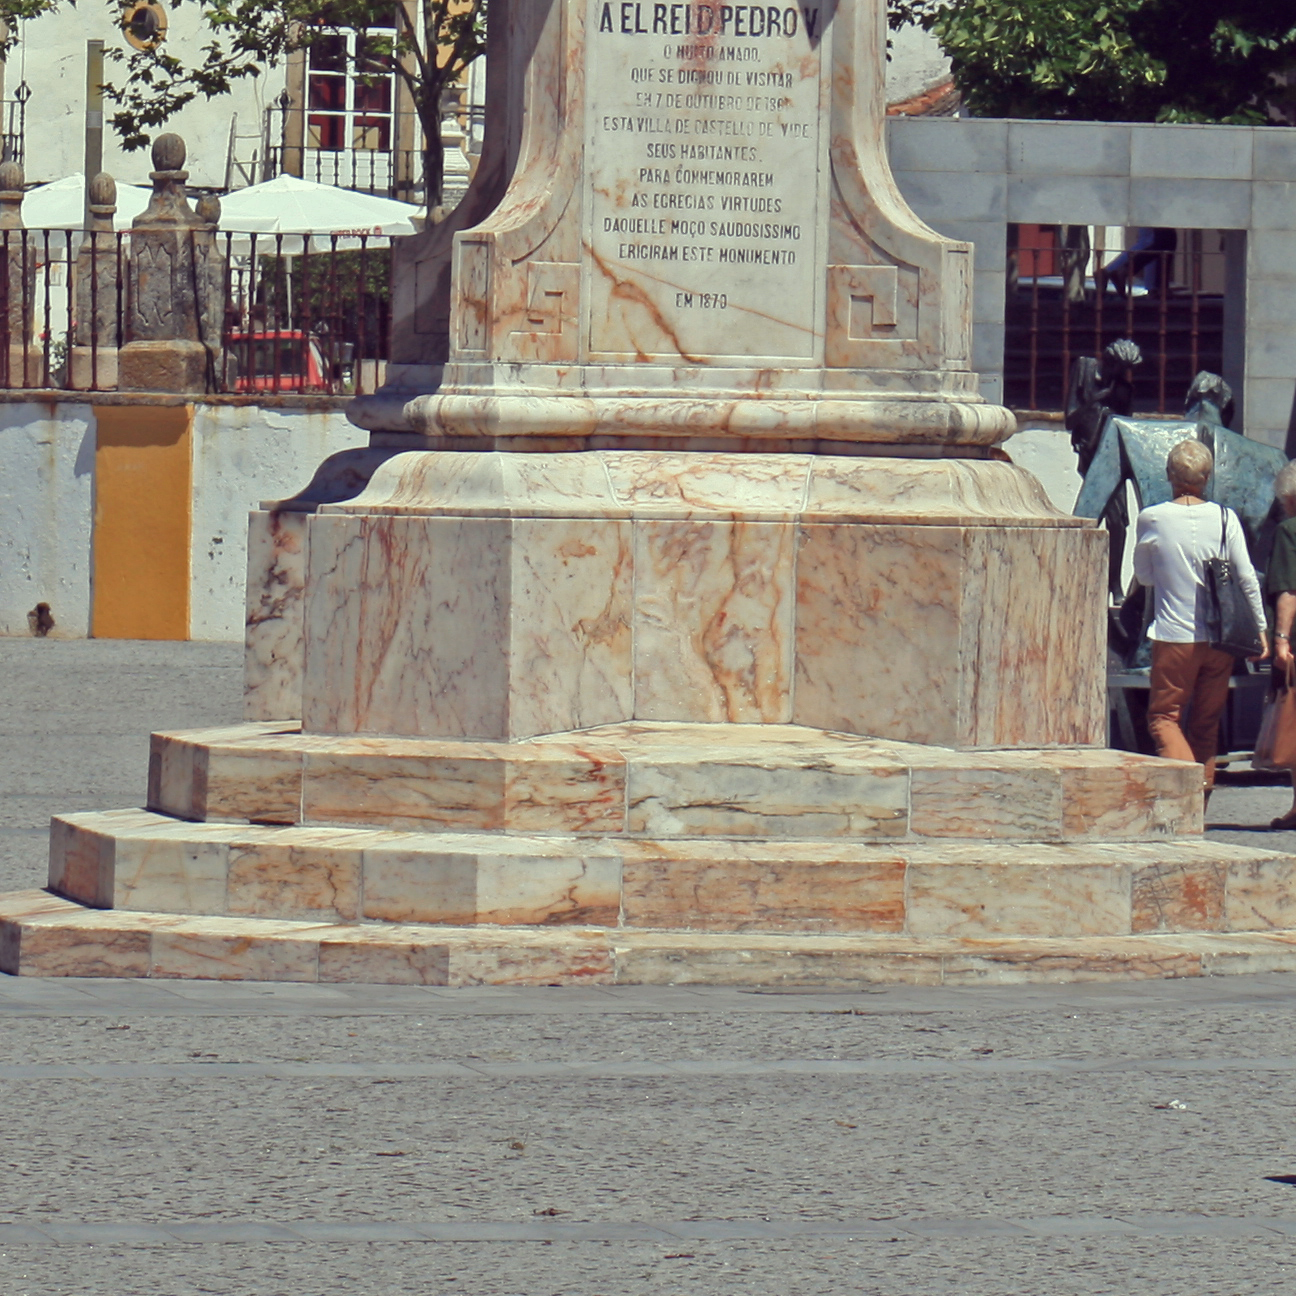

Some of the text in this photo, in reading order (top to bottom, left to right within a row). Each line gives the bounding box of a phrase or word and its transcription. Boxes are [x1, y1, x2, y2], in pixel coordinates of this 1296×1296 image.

[600, 2, 613, 33] A
[620, 3, 648, 34] EL
[654, 3, 690, 35] REI
[720, 5, 798, 38] PEDRO
[664, 44, 672, 59] O
[676, 45, 714, 60] MUITO
[631, 67, 793, 88] QUE SE DIGNOU DE VISITAR
[636, 92, 652, 107] EM
[656, 93, 662, 108] 7
[666, 93, 682, 109] DE
[686, 94, 742, 110] OUTUBRO
[747, 96, 761, 112] DE
[604, 116, 633, 132] ESTA
[637, 117, 671, 134] VILLA
[675, 119, 690, 134] DE
[694, 120, 753, 137] CASTELLO
[759, 122, 773, 136] DE
[647, 143, 676, 159] SEUS
[640, 168, 670, 184] PARA
[632, 193, 648, 208] AS
[720, 196, 782, 213] VIRTUDES
[604, 217, 801, 240] DAQUELLE MOÇO SAUDOSISSIMO
[619, 243, 796, 265] ERIGIRAM ESTE MONUMENTO
[676, 293, 727, 309] EM 1870
